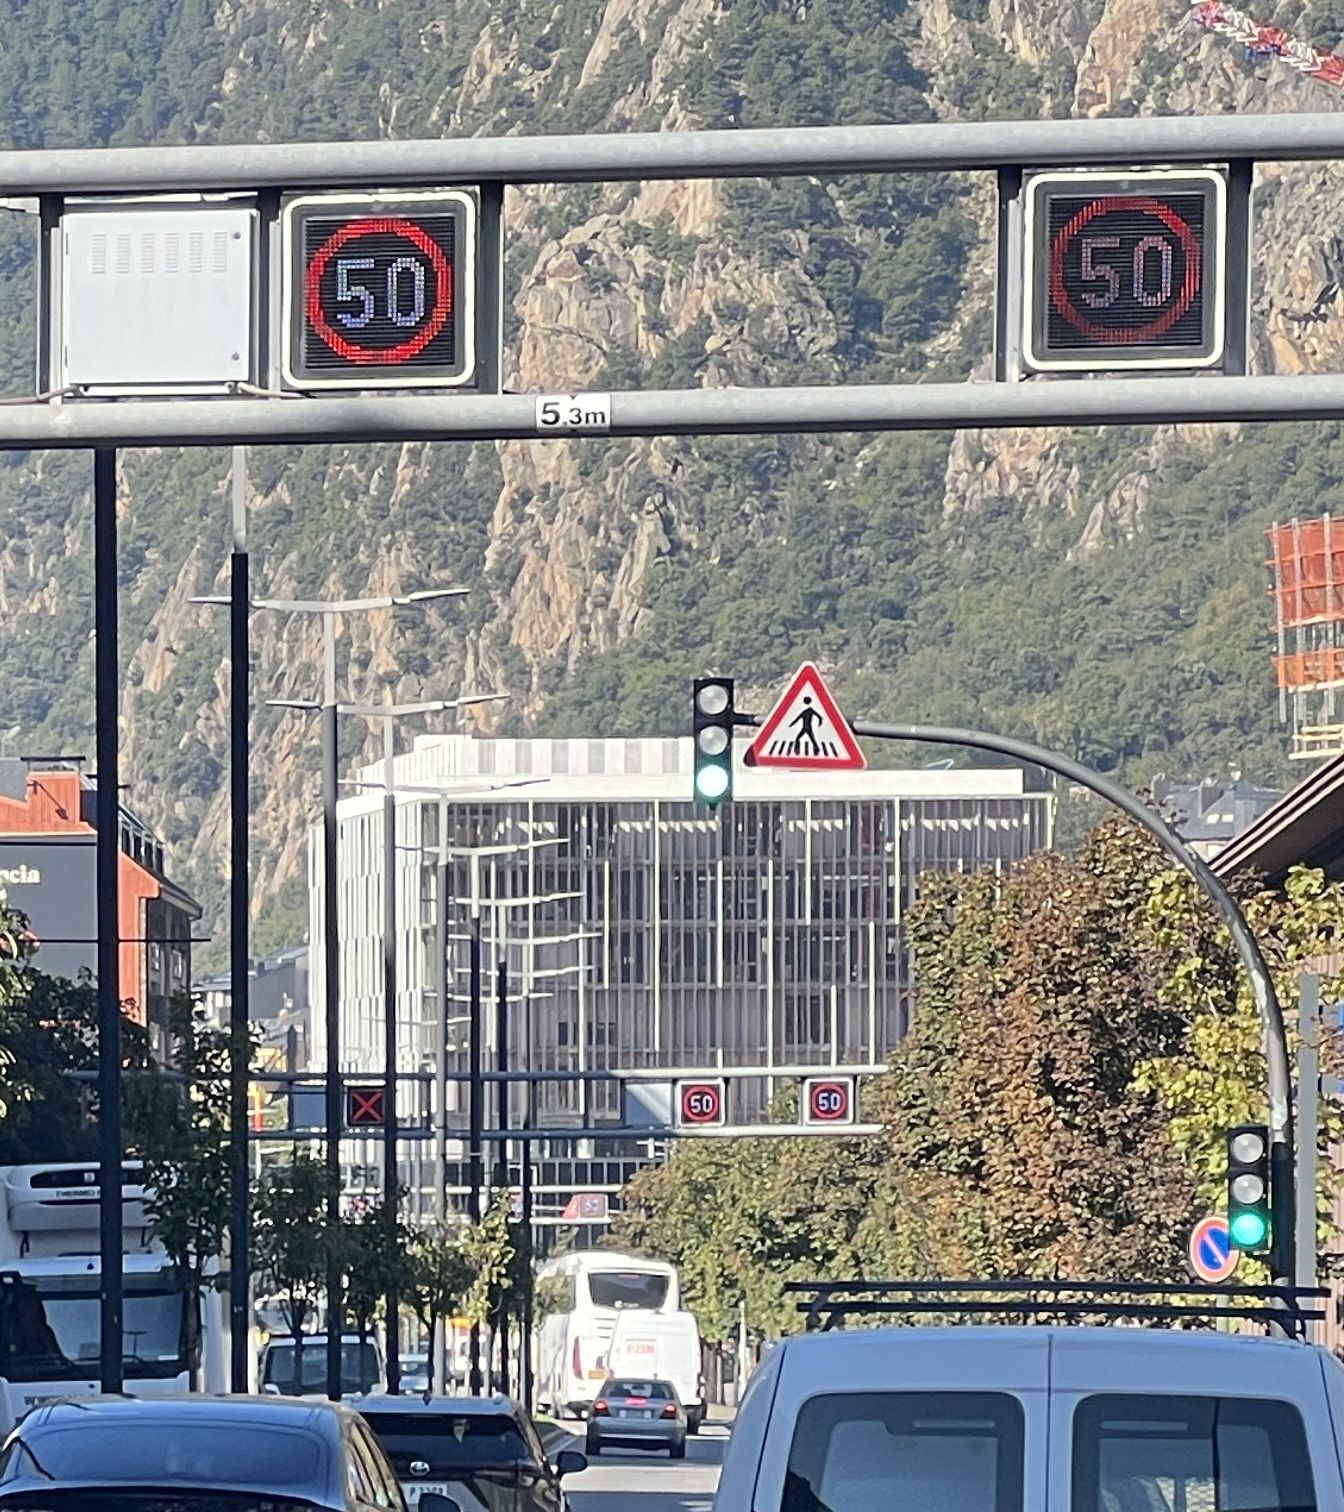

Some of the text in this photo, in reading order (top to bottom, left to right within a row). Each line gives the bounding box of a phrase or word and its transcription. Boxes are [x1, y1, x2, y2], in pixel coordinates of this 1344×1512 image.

[336, 257, 425, 328] 50
[1081, 236, 1173, 308] 50
[690, 1095, 713, 1113] 50
[818, 1092, 841, 1111] 50
